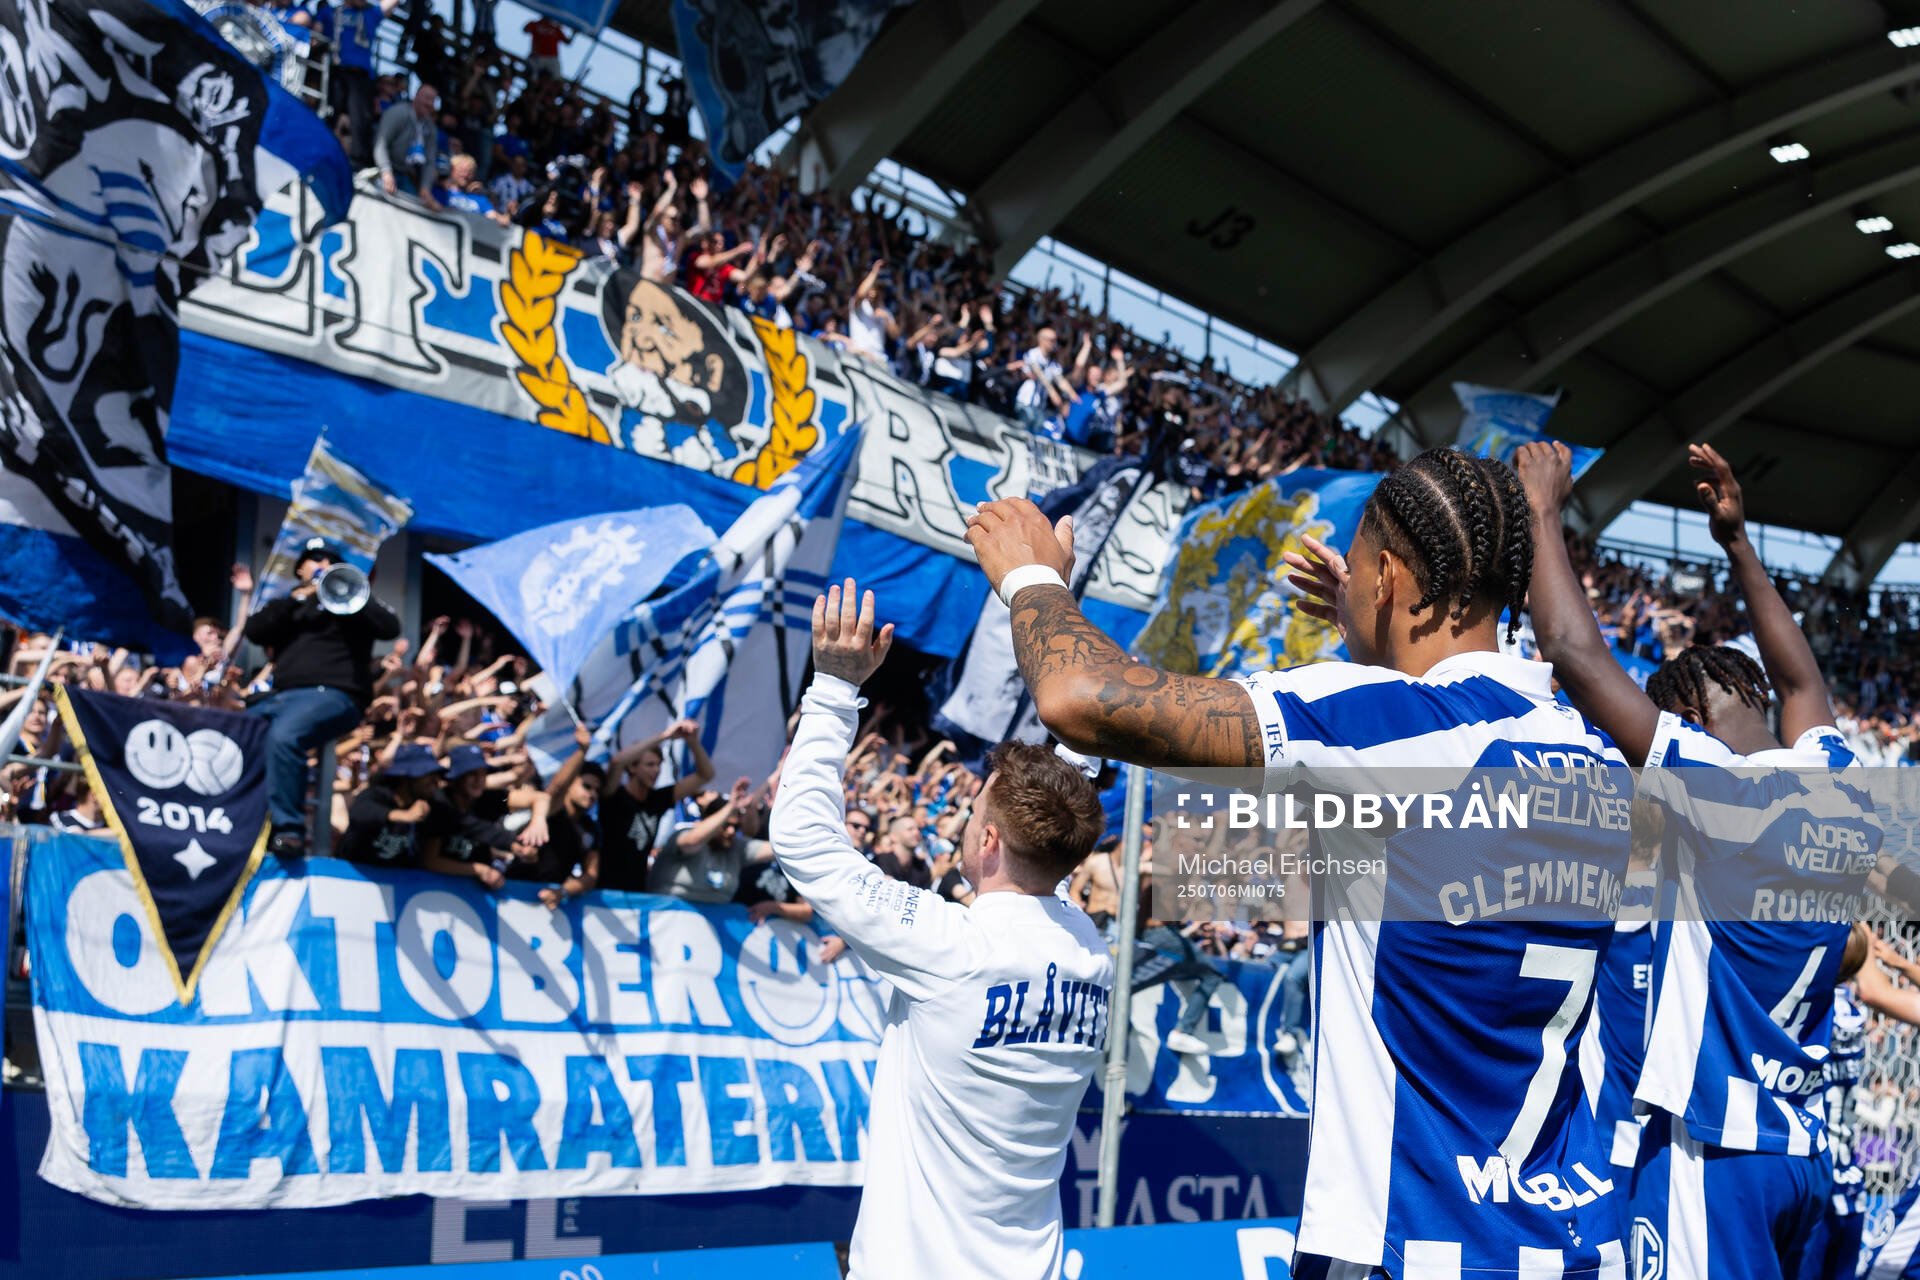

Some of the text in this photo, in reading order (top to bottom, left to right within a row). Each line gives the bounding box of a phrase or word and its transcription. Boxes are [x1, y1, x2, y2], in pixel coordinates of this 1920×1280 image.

[1187, 205, 1256, 250] J3
[1266, 722, 1284, 762] IFK
[136, 796, 234, 835] 2014
[66, 869, 733, 1028] OKTOBER
[1499, 943, 1598, 1176] 7
